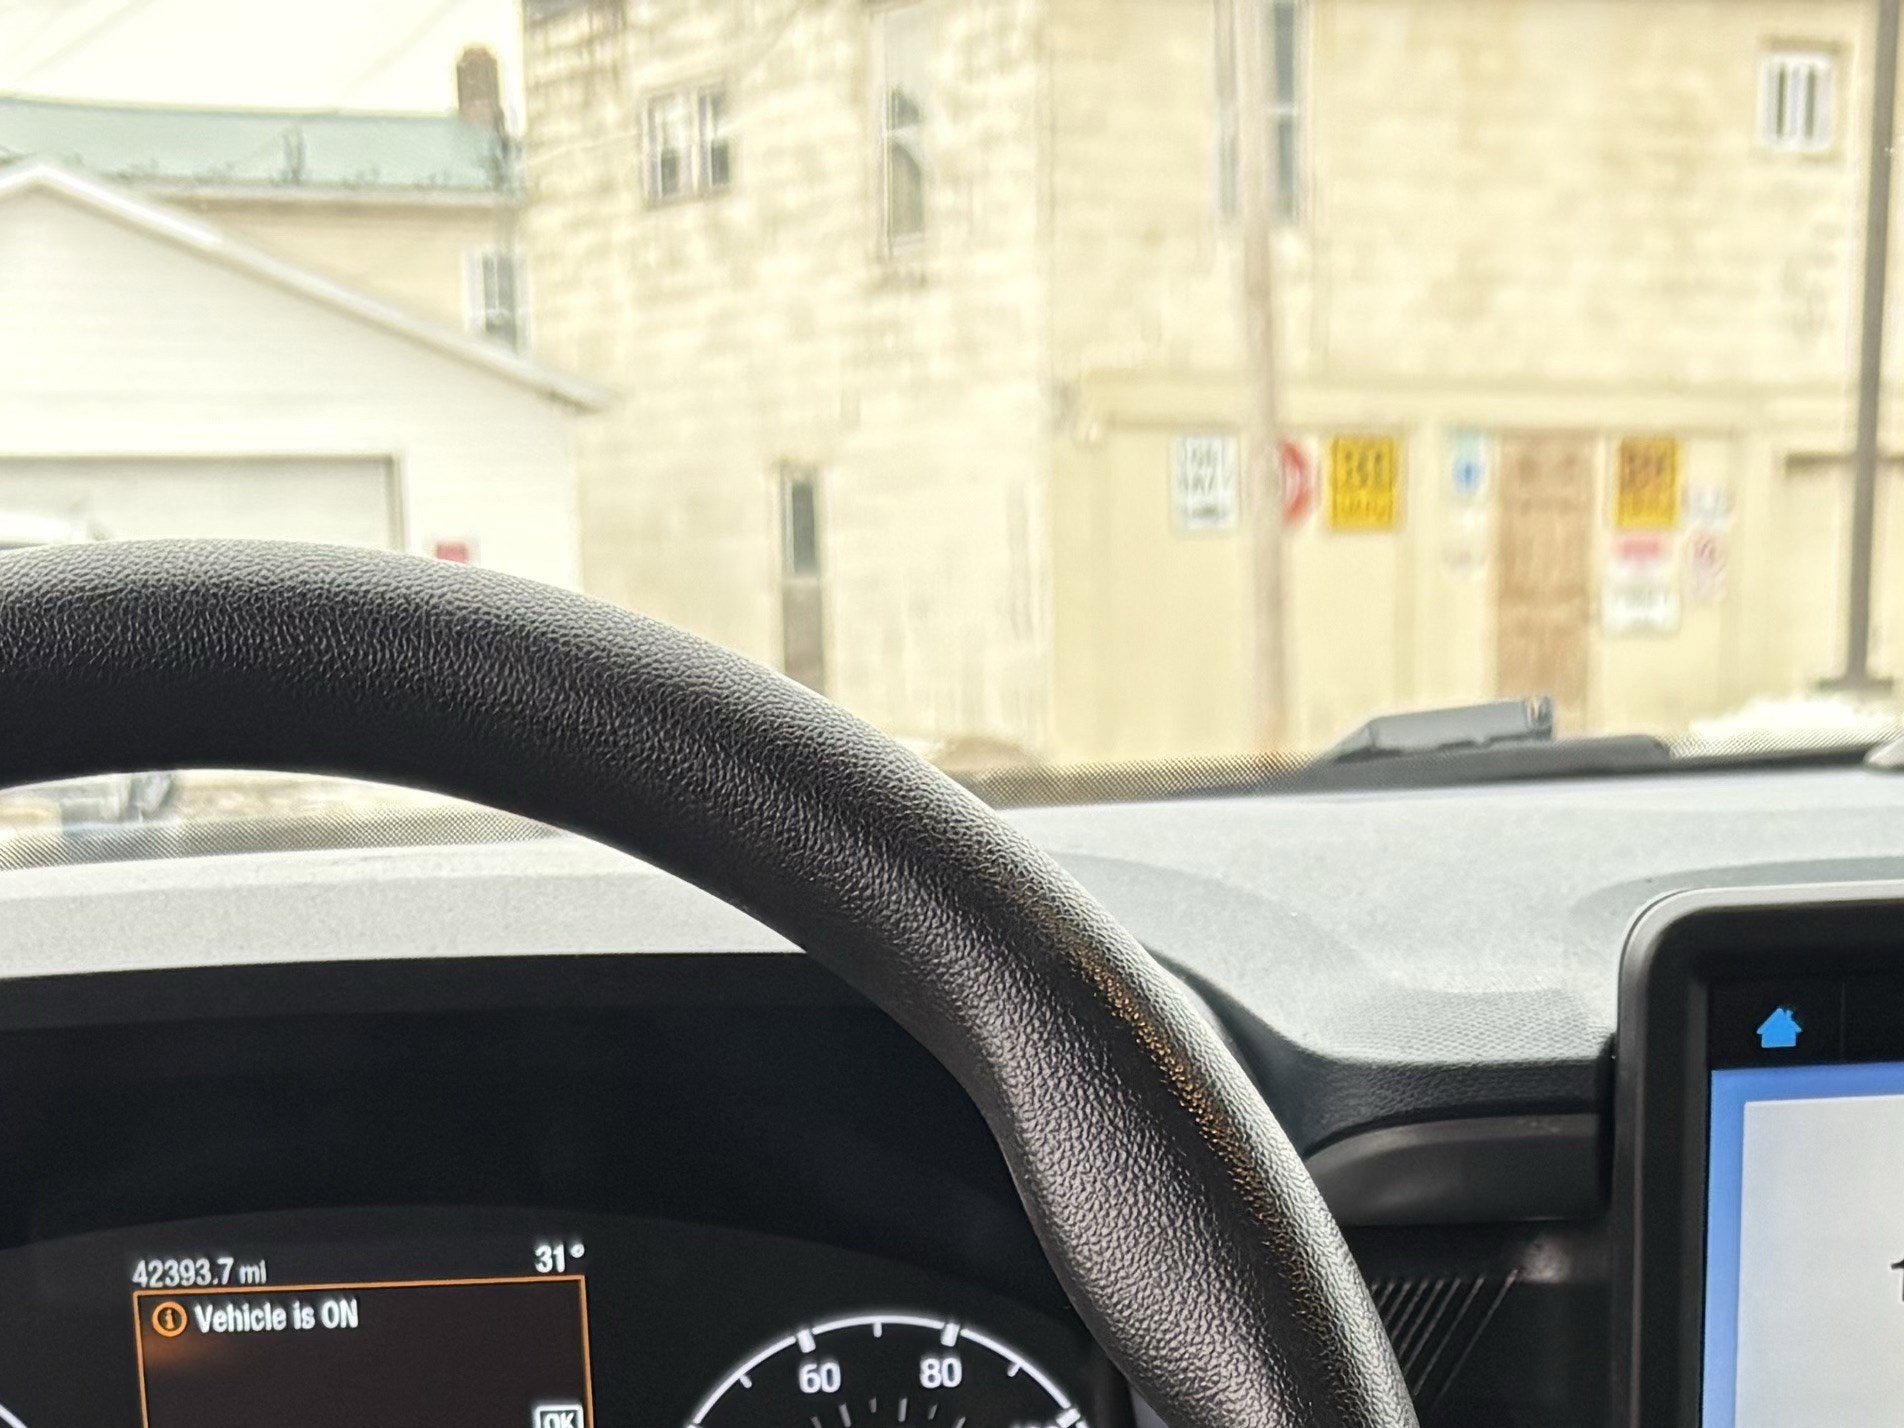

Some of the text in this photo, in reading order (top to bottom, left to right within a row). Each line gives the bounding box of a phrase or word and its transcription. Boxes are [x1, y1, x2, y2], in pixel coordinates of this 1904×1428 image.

[132, 1256, 268, 1289] 42393.7 mi
[533, 1242, 586, 1274] 31°
[194, 1298, 360, 1334] Vehicle is ON
[799, 1361, 842, 1394] 60
[919, 1356, 963, 1388] 80
